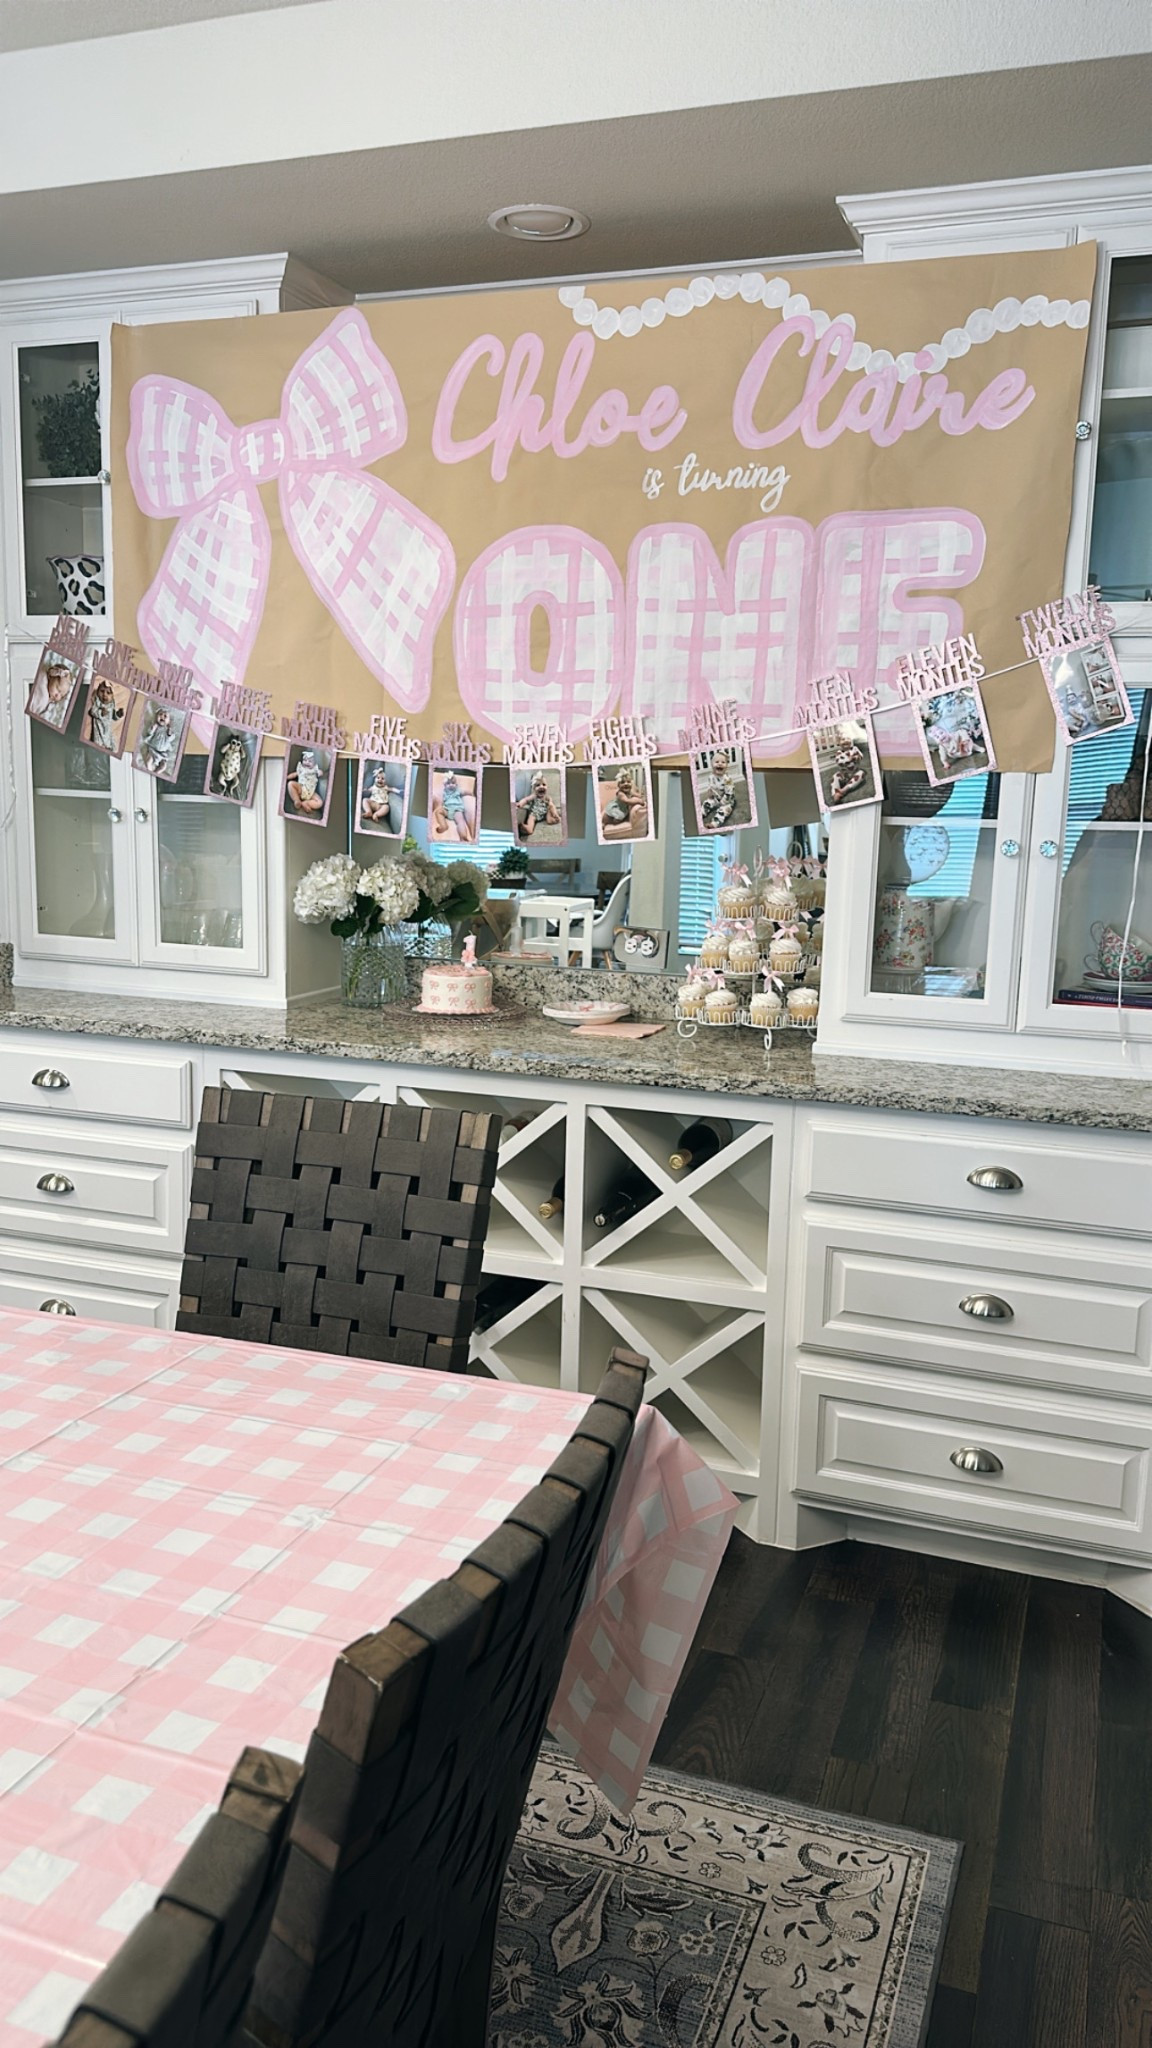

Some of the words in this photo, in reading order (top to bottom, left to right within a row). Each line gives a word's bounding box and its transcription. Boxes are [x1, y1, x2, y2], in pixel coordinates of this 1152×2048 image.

[430, 331, 688, 482] Chloe
[733, 315, 1036, 449] Claire
[642, 467, 664, 499] is
[675, 453, 792, 512] turning
[1015, 584, 1102, 635] TWELVE
[55, 612, 90, 642] NEW
[454, 506, 987, 760] ONE
[1022, 603, 1116, 659] MONTHS
[105, 637, 137, 667] ONE
[896, 633, 979, 677] ELEVEN
[158, 657, 194, 687] TWO
[808, 671, 855, 702] TEN
[896, 653, 986, 701] MONTHS
[139, 674, 204, 710] MONTHS
[220, 680, 272, 712] THREE
[793, 687, 879, 727] MONTHS
[210, 697, 275, 733] MONTHS
[294, 701, 338, 728] FOUR
[370, 714, 408, 737] FIVE
[690, 696, 737, 727] NINE
[282, 717, 348, 749] MONTHS
[442, 721, 472, 745] SIX
[512, 722, 569, 745] SEVEN
[589, 715, 645, 740] EIGHT
[677, 717, 756, 751] MONTHS
[353, 731, 421, 760] MONTHS
[421, 741, 493, 765] MONTHS
[503, 742, 575, 766] MONTHS
[583, 733, 657, 761] MONTHS
